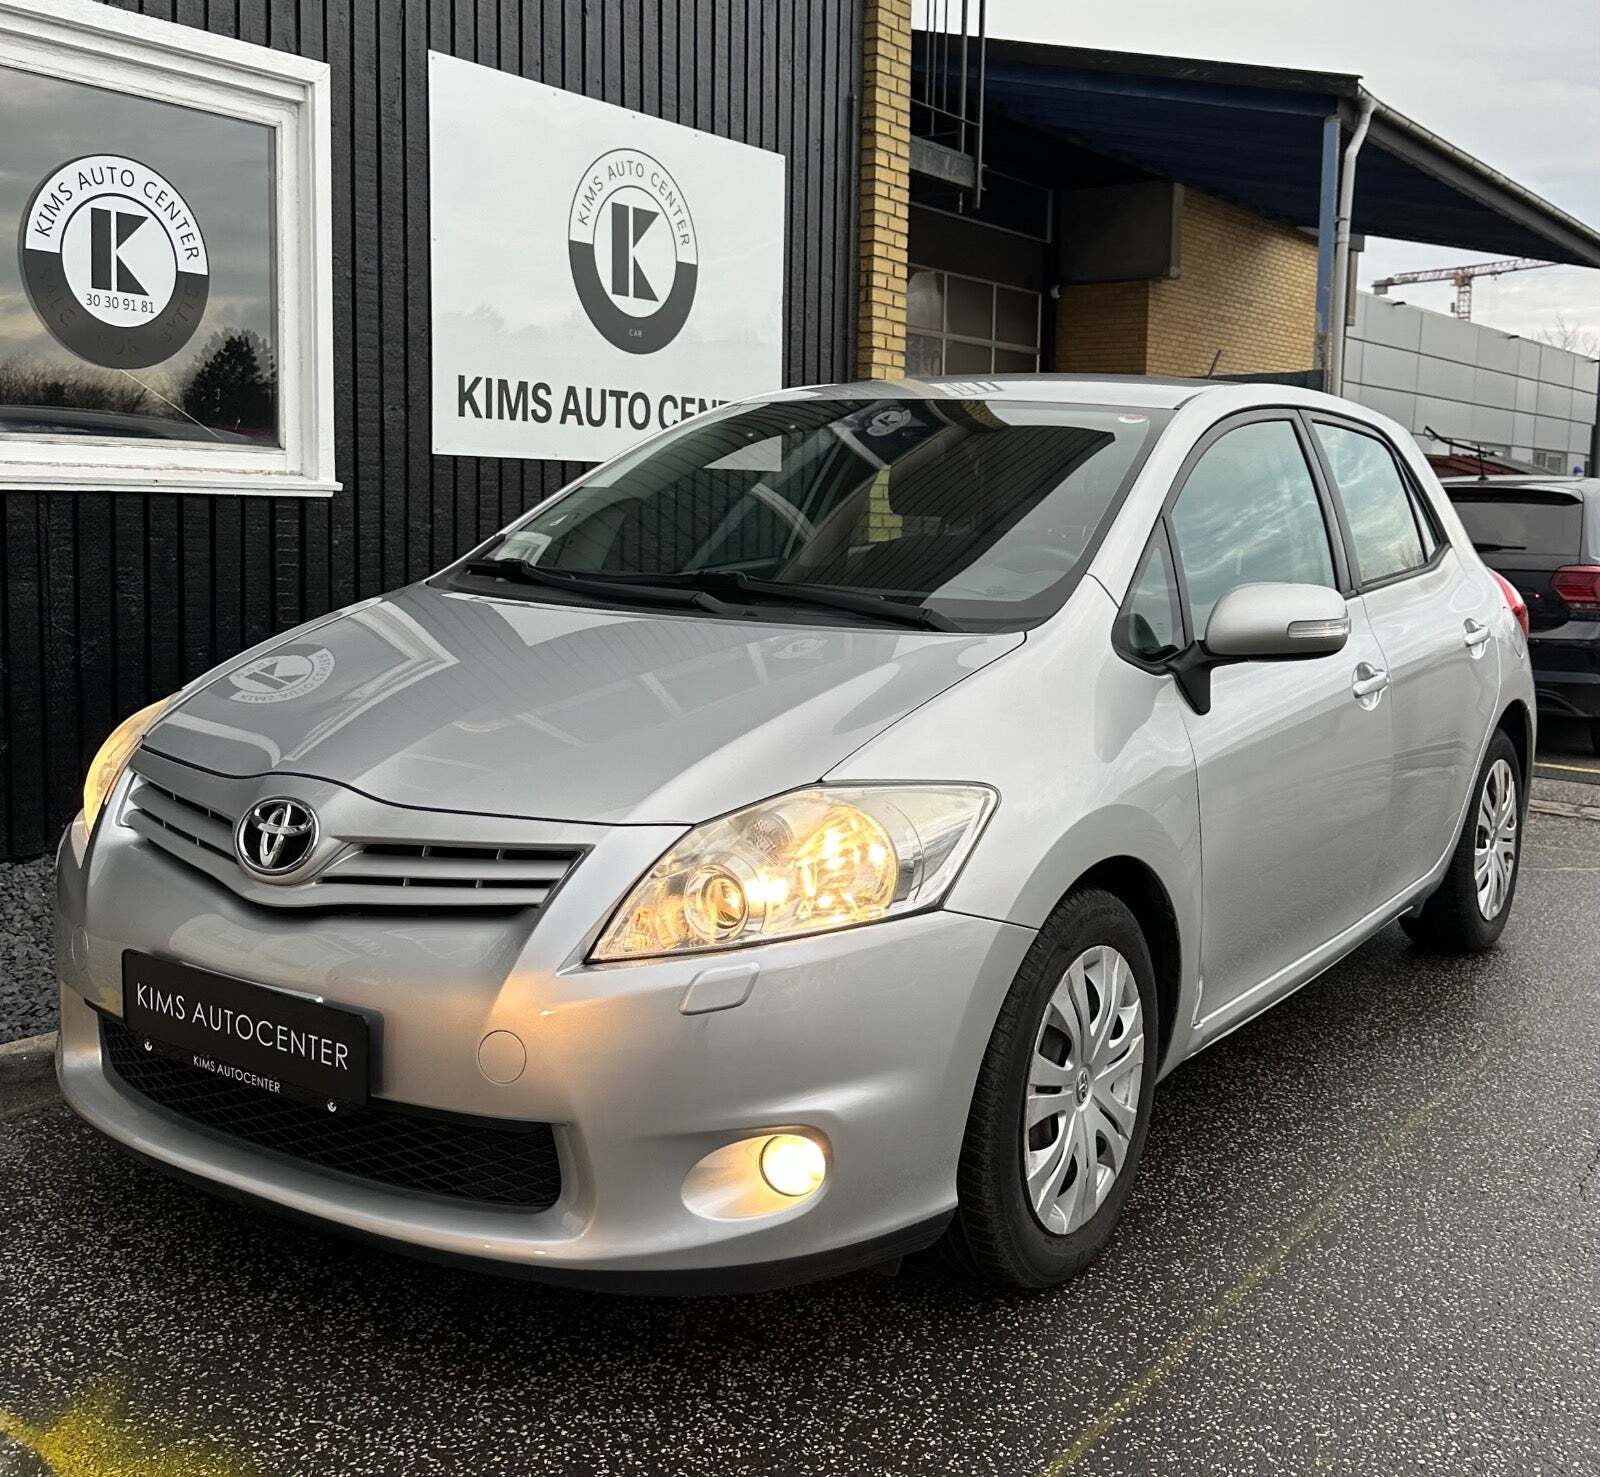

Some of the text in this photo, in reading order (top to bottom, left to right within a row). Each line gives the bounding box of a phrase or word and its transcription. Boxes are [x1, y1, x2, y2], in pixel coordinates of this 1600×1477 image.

[35, 166, 200, 261] KIMS AUTO CENTER
[577, 160, 690, 247] KIMS AUTO CENTER
[90, 207, 150, 297] K
[611, 201, 660, 302] K
[86, 293, 155, 315] 30 30 91 81
[457, 374, 553, 424] KIMS
[559, 386, 651, 431] AUTO
[136, 982, 348, 1070] KIMS AUTOCENTER
[193, 1055, 281, 1094] KIMS AUTOCENTER
